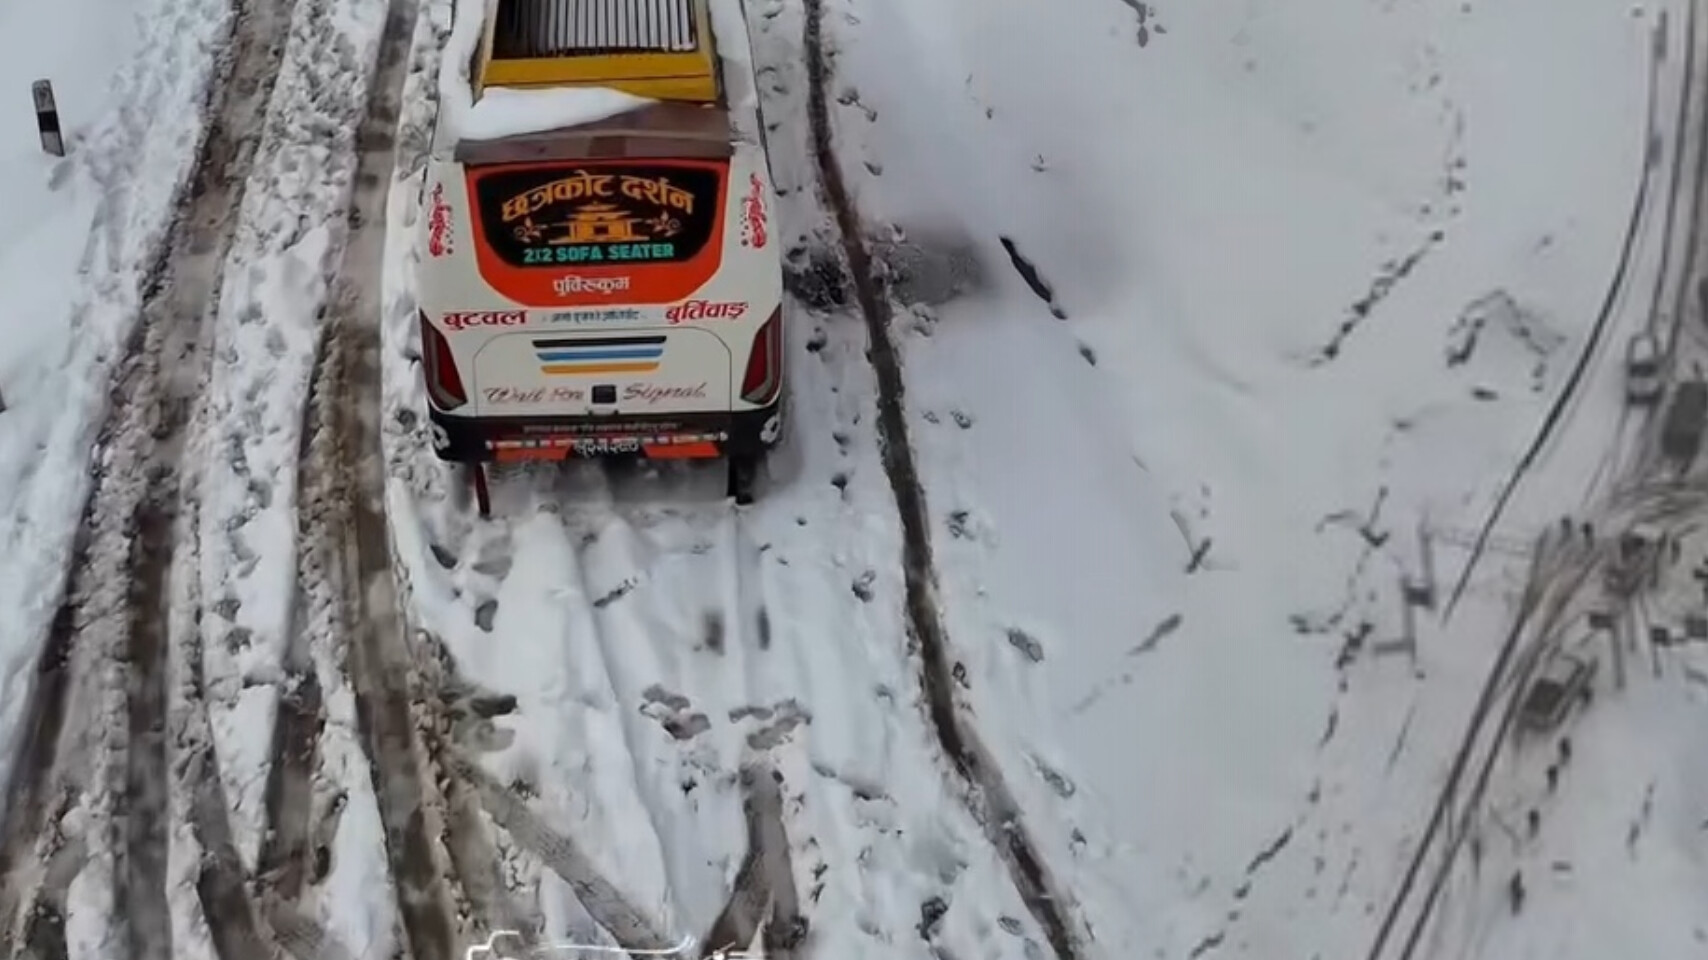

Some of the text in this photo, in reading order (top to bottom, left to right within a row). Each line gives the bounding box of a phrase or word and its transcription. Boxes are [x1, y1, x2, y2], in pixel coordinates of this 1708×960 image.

[620, 175, 695, 214] दर्शन
[556, 245, 603, 262] SOFA
[608, 243, 674, 260] SEATER
[443, 310, 528, 330] बुटवल
